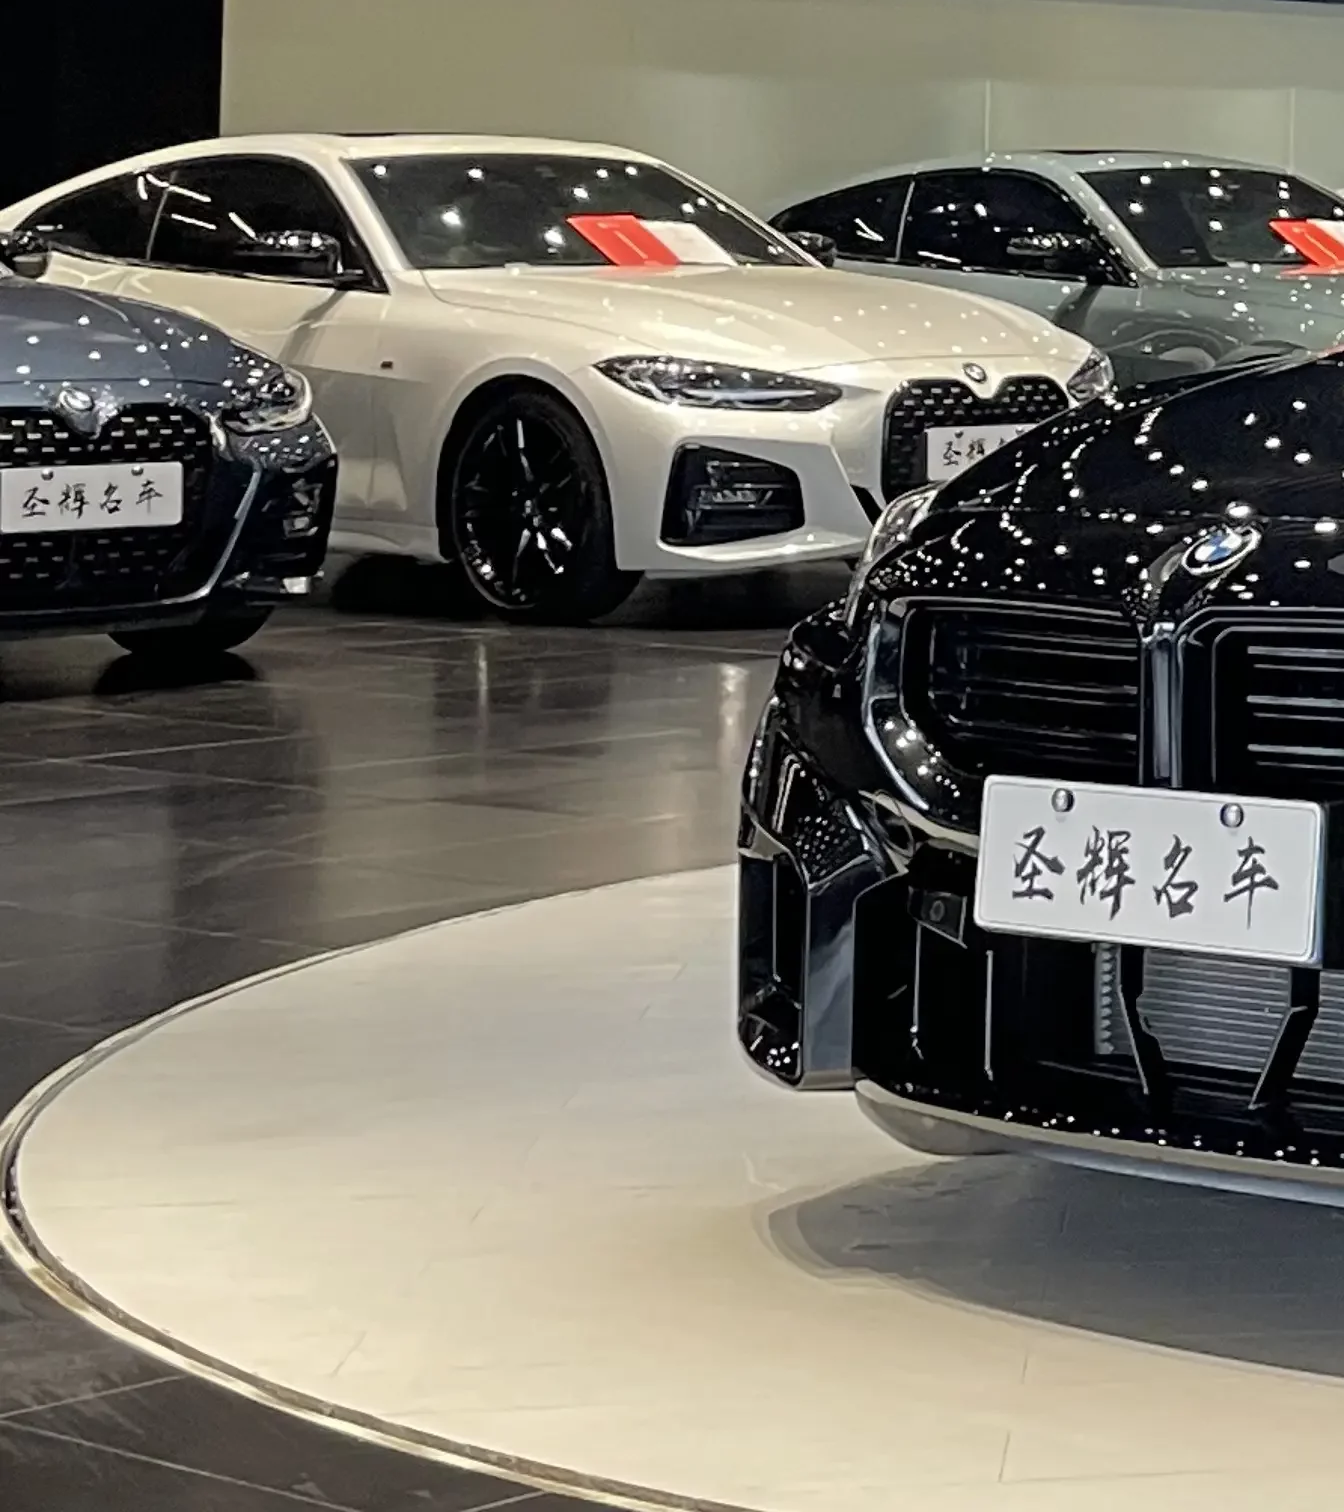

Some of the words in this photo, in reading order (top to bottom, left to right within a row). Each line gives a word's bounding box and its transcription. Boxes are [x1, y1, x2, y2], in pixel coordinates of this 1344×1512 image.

[942, 437, 1006, 466] 圣辉
[21, 479, 163, 519] 圣辉名车
[1011, 824, 1280, 930] 圣辉名车
